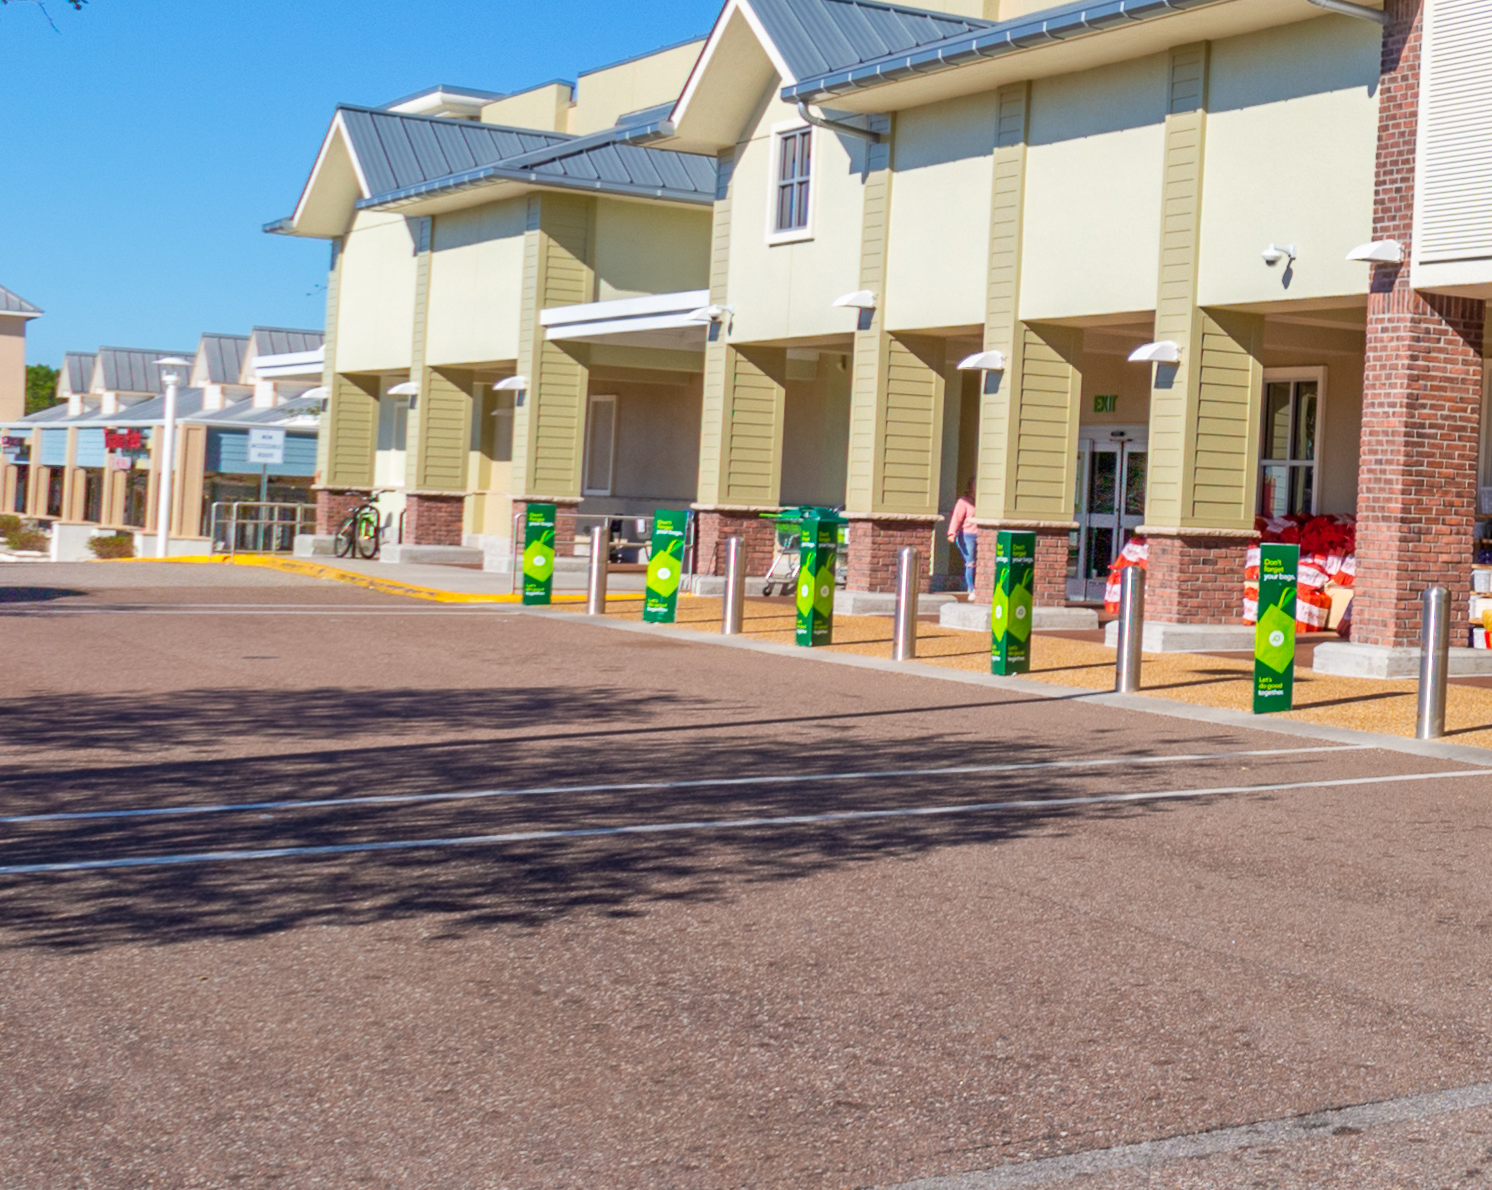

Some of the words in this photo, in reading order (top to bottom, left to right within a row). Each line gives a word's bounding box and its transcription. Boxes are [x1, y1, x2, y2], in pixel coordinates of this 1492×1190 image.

[1093, 395, 1118, 412] EXIT
[1264, 558, 1282, 566] Don't
[1264, 566, 1284, 574] forget
[1268, 683, 1283, 691] good
